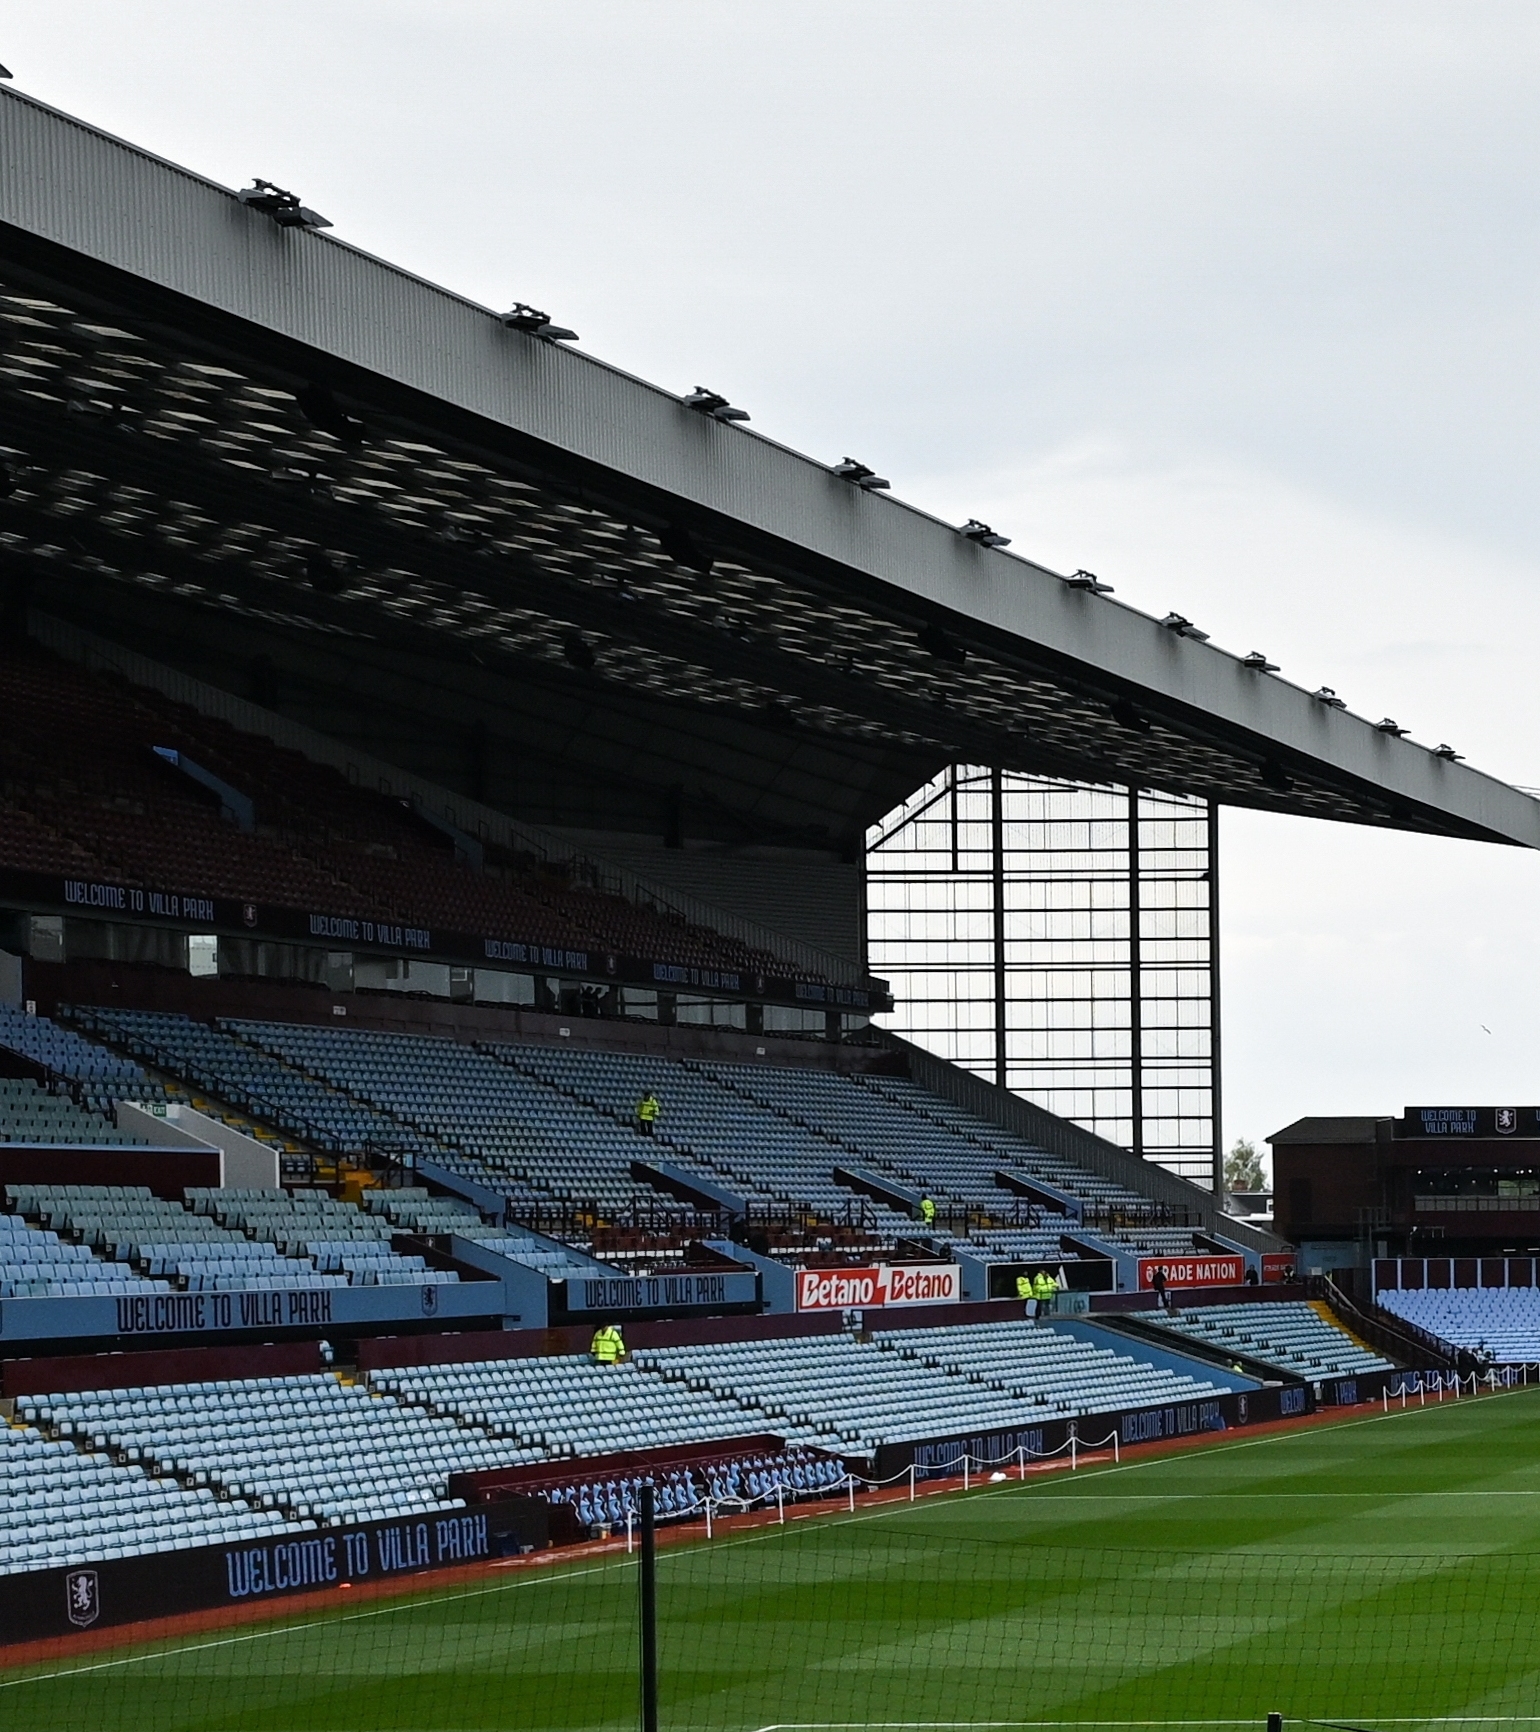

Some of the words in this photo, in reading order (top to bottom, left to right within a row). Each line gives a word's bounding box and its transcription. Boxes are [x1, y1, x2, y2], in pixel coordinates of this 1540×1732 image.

[65, 880, 125, 909] WELCOME
[130, 888, 144, 912] TO
[149, 892, 179, 917] VILLA
[183, 897, 214, 921] PARK
[310, 913, 360, 940] WELCOME
[362, 921, 374, 942] TO
[377, 923, 402, 946] VILLA
[405, 927, 431, 949] PARK
[484, 938, 525, 961] WELCOME
[528, 944, 539, 964] TO
[542, 946, 563, 968] VILLA
[566, 948, 588, 971] PARK
[1421, 1109, 1464, 1122] WELCOME
[1466, 1109, 1476, 1121] TO
[1424, 1121, 1447, 1133] VILLA
[1450, 1121, 1475, 1133] PARK
[890, 1270, 952, 1301] Betano
[1196, 1262, 1236, 1280] NATION
[585, 1279, 642, 1308] WELCOME
[646, 1278, 659, 1306] TO
[664, 1276, 692, 1304] VILLA
[696, 1276, 725, 1302] PARK
[802, 1273, 875, 1307] Betano
[116, 1295, 205, 1332] WELCOME
[211, 1294, 231, 1328] TO
[239, 1293, 282, 1326] VILLA
[288, 1290, 332, 1324] PARK
[1121, 1410, 1163, 1443] WELCOME
[1164, 1408, 1175, 1434] TO
[1177, 1404, 1198, 1433] VILLA
[225, 1536, 337, 1598] WELCOME
[343, 1531, 369, 1577] TO
[376, 1522, 430, 1572] VILLA
[435, 1514, 489, 1562] PARK
